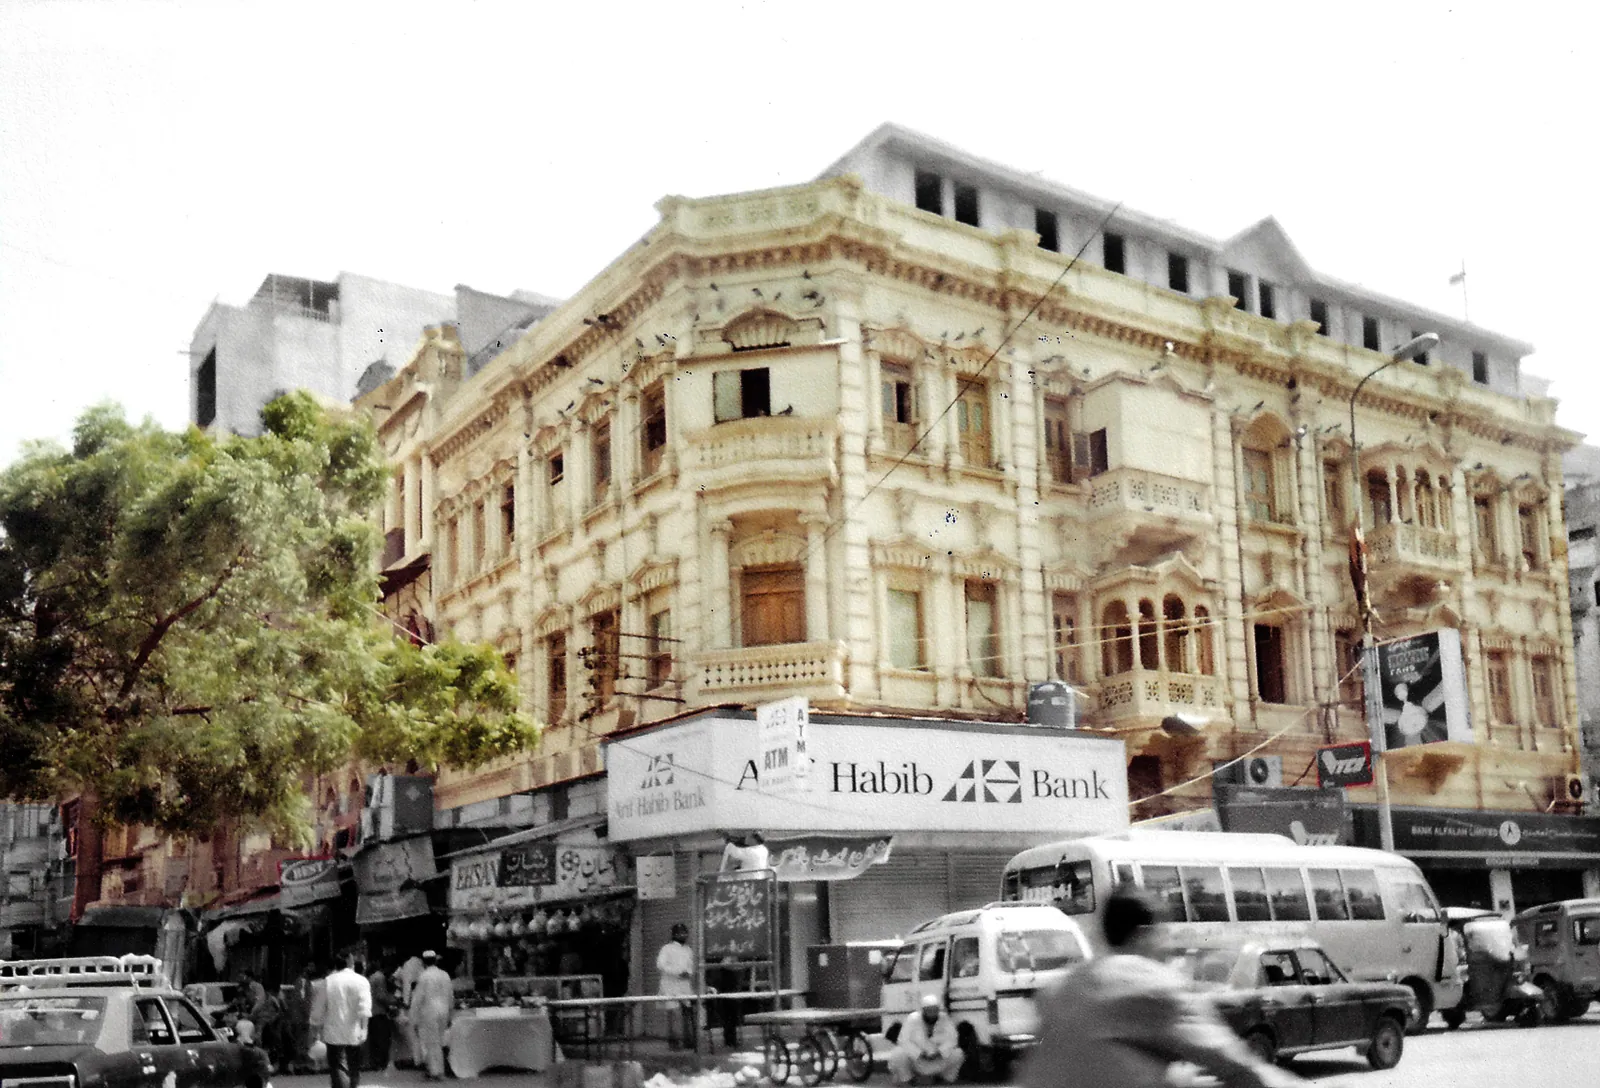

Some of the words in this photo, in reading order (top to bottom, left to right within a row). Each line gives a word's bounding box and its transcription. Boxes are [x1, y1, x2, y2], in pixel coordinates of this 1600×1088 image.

[797, 708, 806, 753] ATM
[765, 747, 788, 770] ATM
[830, 760, 934, 796] Habib
[1031, 769, 1110, 800] Bank
[673, 786, 706, 811] Bank
